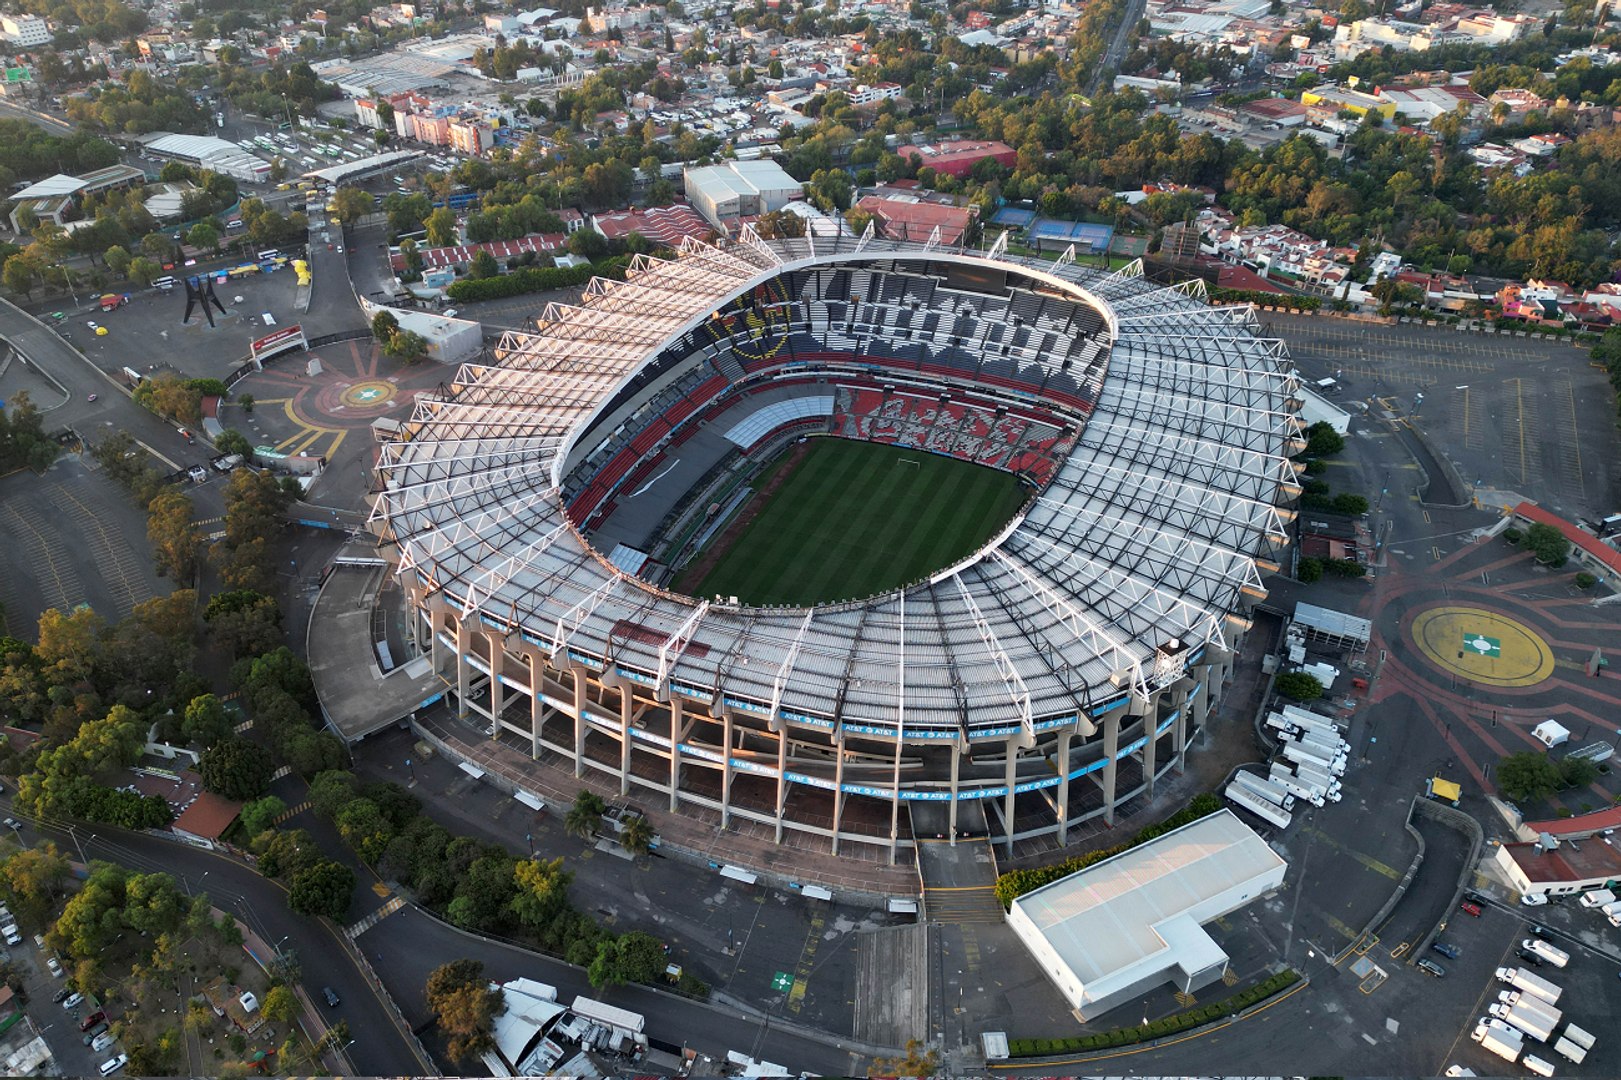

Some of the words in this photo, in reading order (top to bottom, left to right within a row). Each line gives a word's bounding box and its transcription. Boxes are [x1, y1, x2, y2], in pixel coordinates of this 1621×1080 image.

[845, 725, 863, 733] AT&T
[969, 730, 987, 738] AT&T
[997, 727, 1016, 735] AT&T
[936, 731, 955, 739] AT&T
[1016, 784, 1033, 792] AT&T
[872, 789, 891, 797] AT&T
[931, 792, 949, 800] AT&T
[960, 791, 977, 799] AT&T
[986, 789, 1005, 797] AT&T
